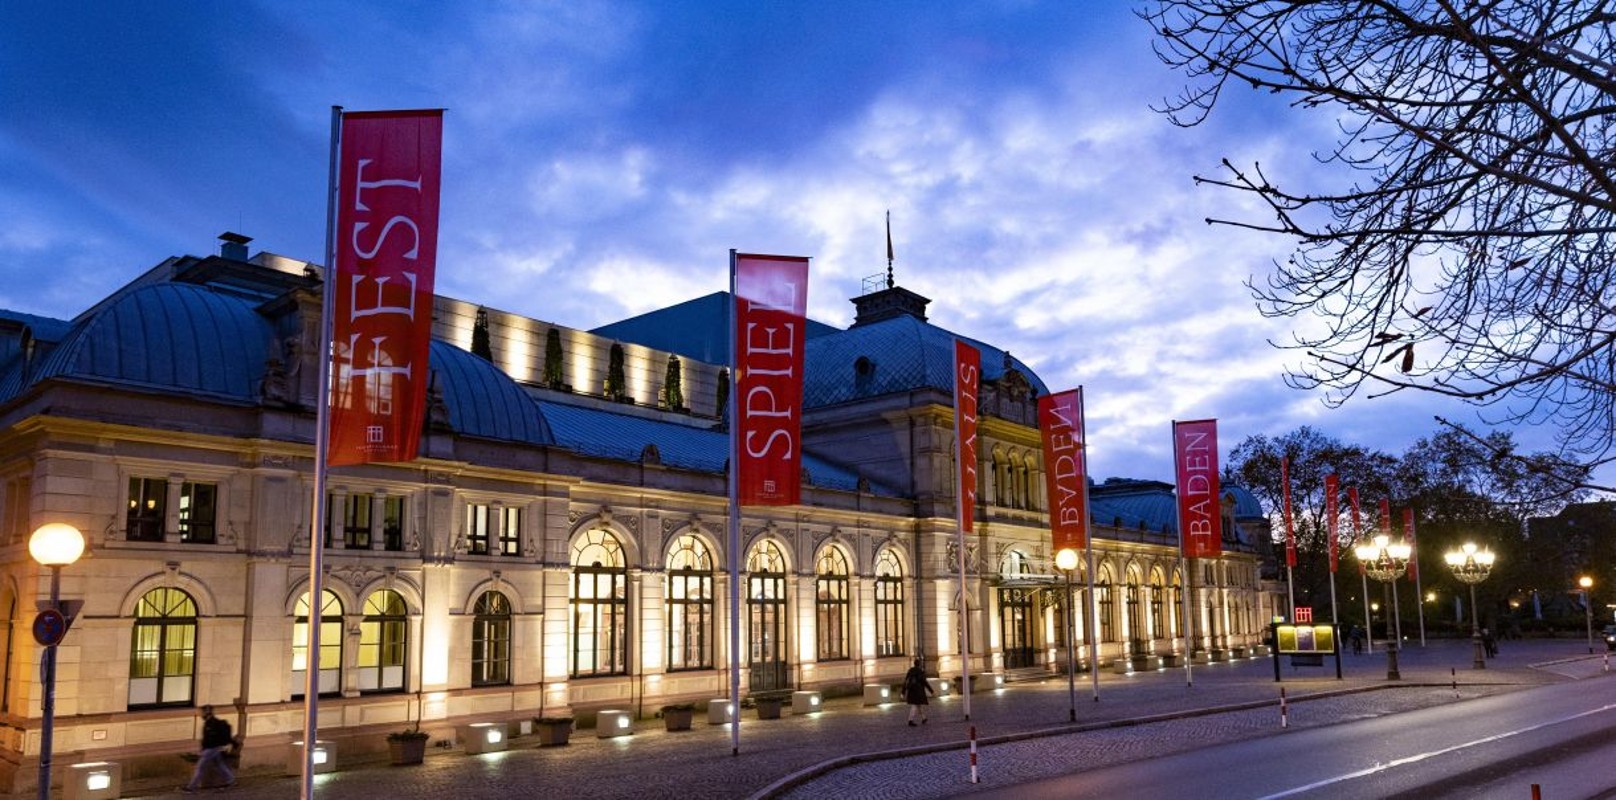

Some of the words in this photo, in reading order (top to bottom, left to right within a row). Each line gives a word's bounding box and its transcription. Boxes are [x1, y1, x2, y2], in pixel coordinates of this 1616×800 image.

[350, 158, 422, 380] FEST
[746, 283, 796, 460] SPIEL
[1185, 432, 1212, 537] BADEN
